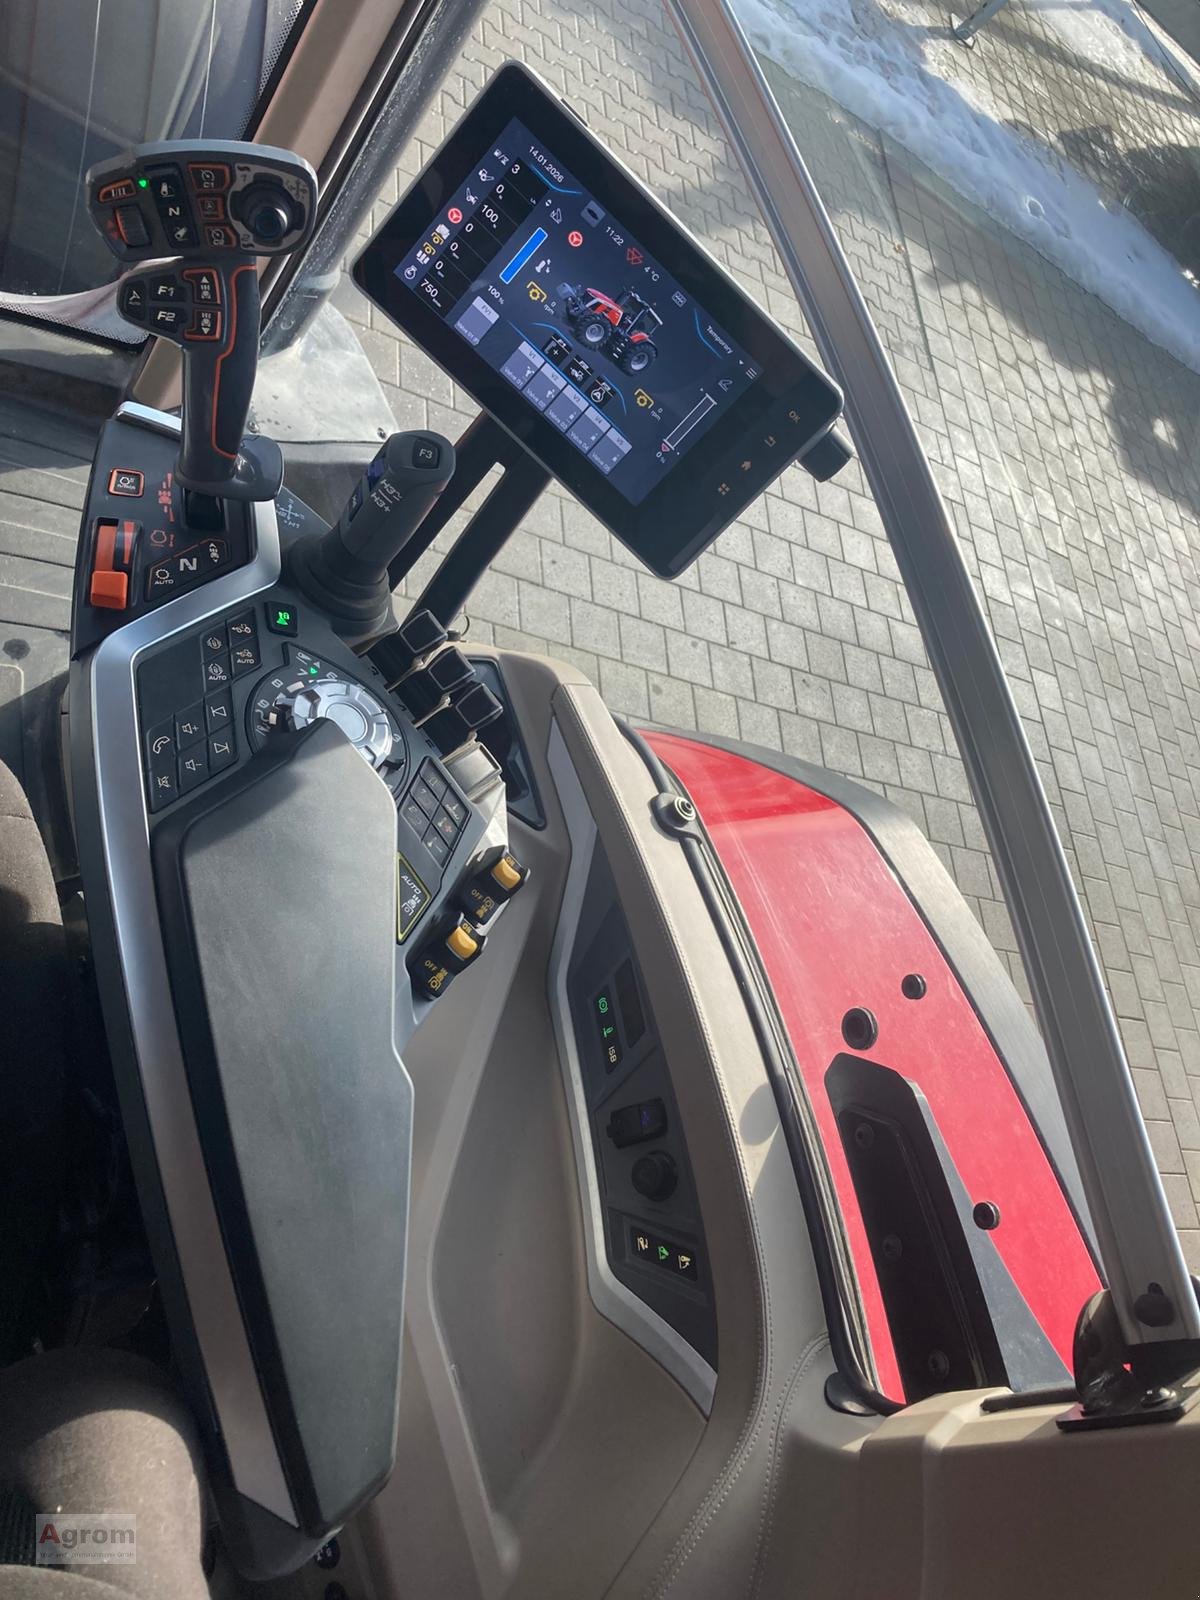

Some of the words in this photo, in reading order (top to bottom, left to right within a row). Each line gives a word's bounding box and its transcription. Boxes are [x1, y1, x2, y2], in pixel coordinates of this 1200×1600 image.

[512, 164, 520, 174] 3
[529, 146, 564, 182] 14.01.2026
[496, 184, 505, 194] 0
[168, 206, 180, 217] N
[481, 204, 499, 224] 100
[465, 222, 474, 232] 0
[606, 226, 624, 246] 11:22
[450, 242, 459, 251] 0
[435, 260, 444, 270] 0
[158, 286, 175, 296] F1
[420, 278, 438, 298] 750
[488, 285, 500, 298] 100
[157, 310, 176, 322] F2
[419, 448, 433, 460] F3
[178, 558, 198, 572] N
[401, 875, 422, 895] AUTO
[471, 888, 484, 900] OFF
[424, 960, 438, 972] OFF
[608, 1046, 617, 1063] ISB
